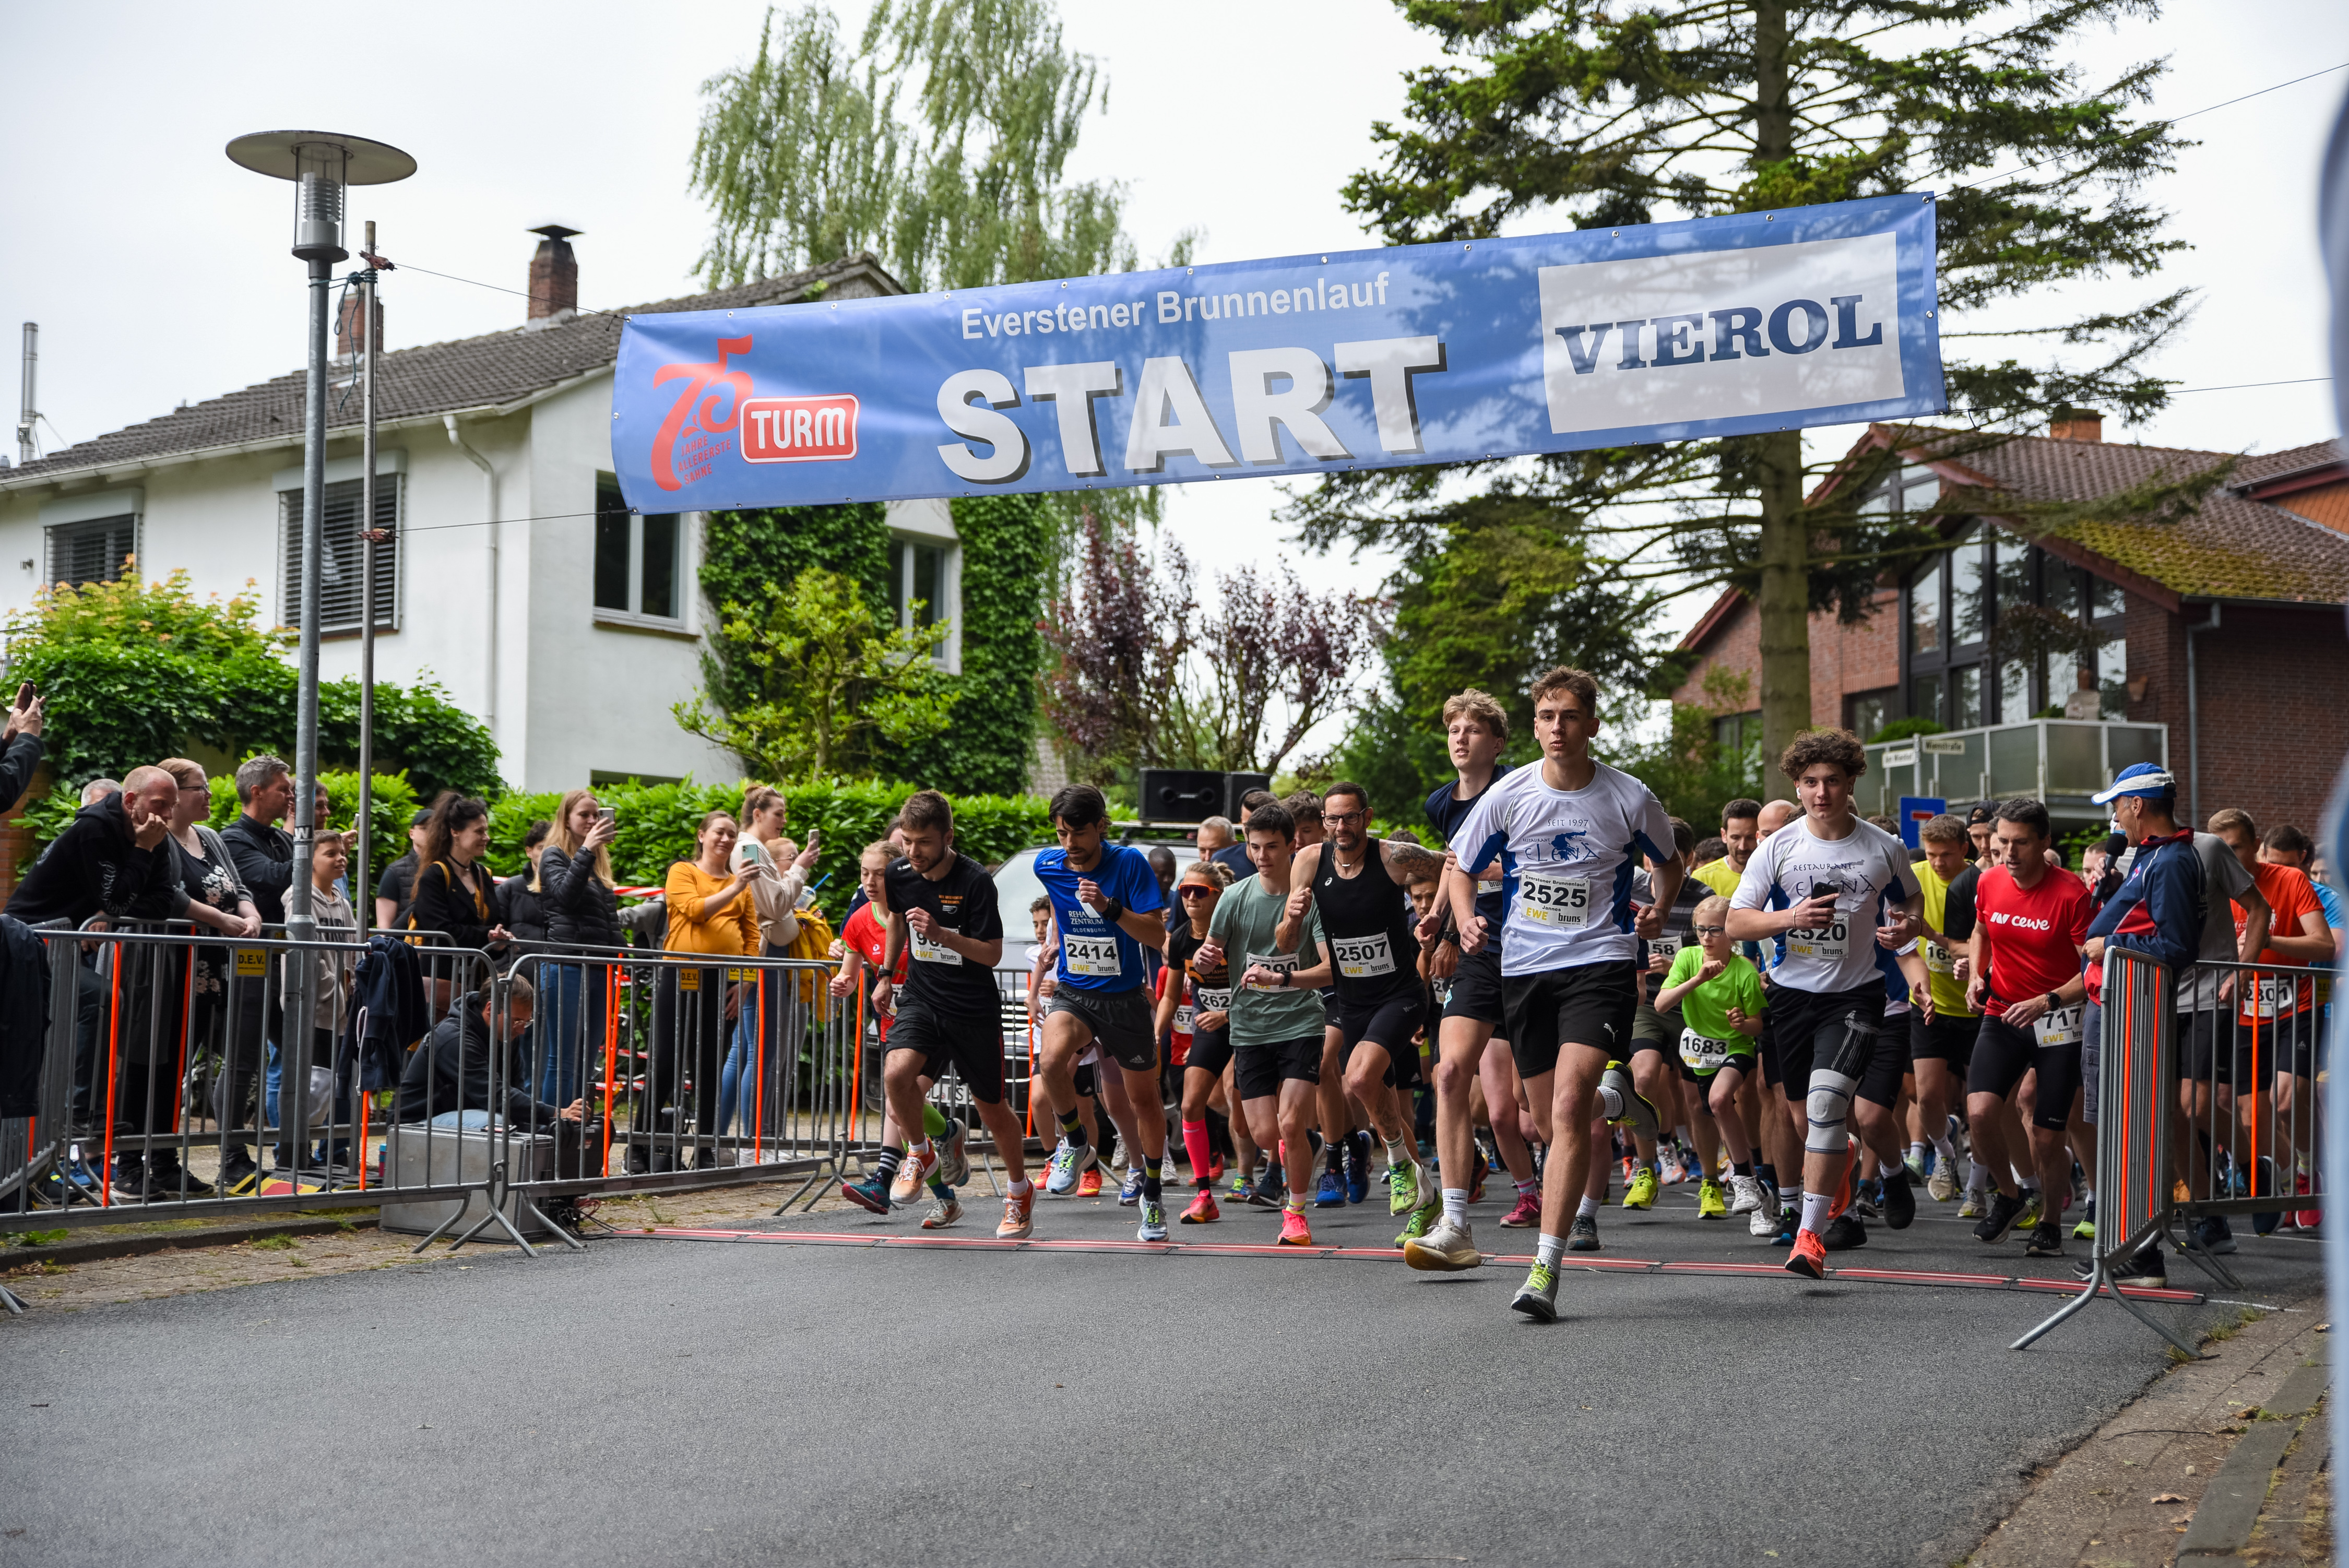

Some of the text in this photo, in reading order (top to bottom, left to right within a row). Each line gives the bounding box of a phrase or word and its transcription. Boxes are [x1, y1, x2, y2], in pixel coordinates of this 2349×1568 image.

[962, 271, 1390, 340] Everstener Brunnenlauf
[1555, 294, 1883, 375] VIEROL
[650, 333, 754, 492] 75
[937, 335, 1447, 484] START
[751, 407, 846, 449] TURM
[681, 434, 708, 457] JAHRE
[678, 438, 731, 473] ALLERERSTE
[684, 462, 713, 484] SAHNE
[1547, 818, 1565, 827] SEIT
[1794, 863, 1853, 872] RESTAURANT
[1525, 875, 1551, 884] Everstener
[1523, 881, 1587, 908] 2525
[1526, 907, 1581, 923] EWE bruns
[2011, 915, 2050, 931] cewe
[1358, 936, 1384, 945] Brunnenlauf
[1787, 923, 1846, 942] 2520
[915, 949, 957, 961] EWE bruns
[1066, 943, 1117, 960] 2414
[1336, 941, 1387, 961] 2507
[1791, 944, 1843, 955] EWE bruns
[1928, 946, 1952, 960] 16
[238, 955, 265, 965] D.E.V.
[1072, 964, 1090, 972] EWE
[1370, 963, 1390, 971] bruns
[681, 972, 697, 981] D.E.V.
[1200, 994, 1230, 1008] 262
[1682, 1036, 1727, 1055] 1683
[2043, 1033, 2064, 1043] EWE
